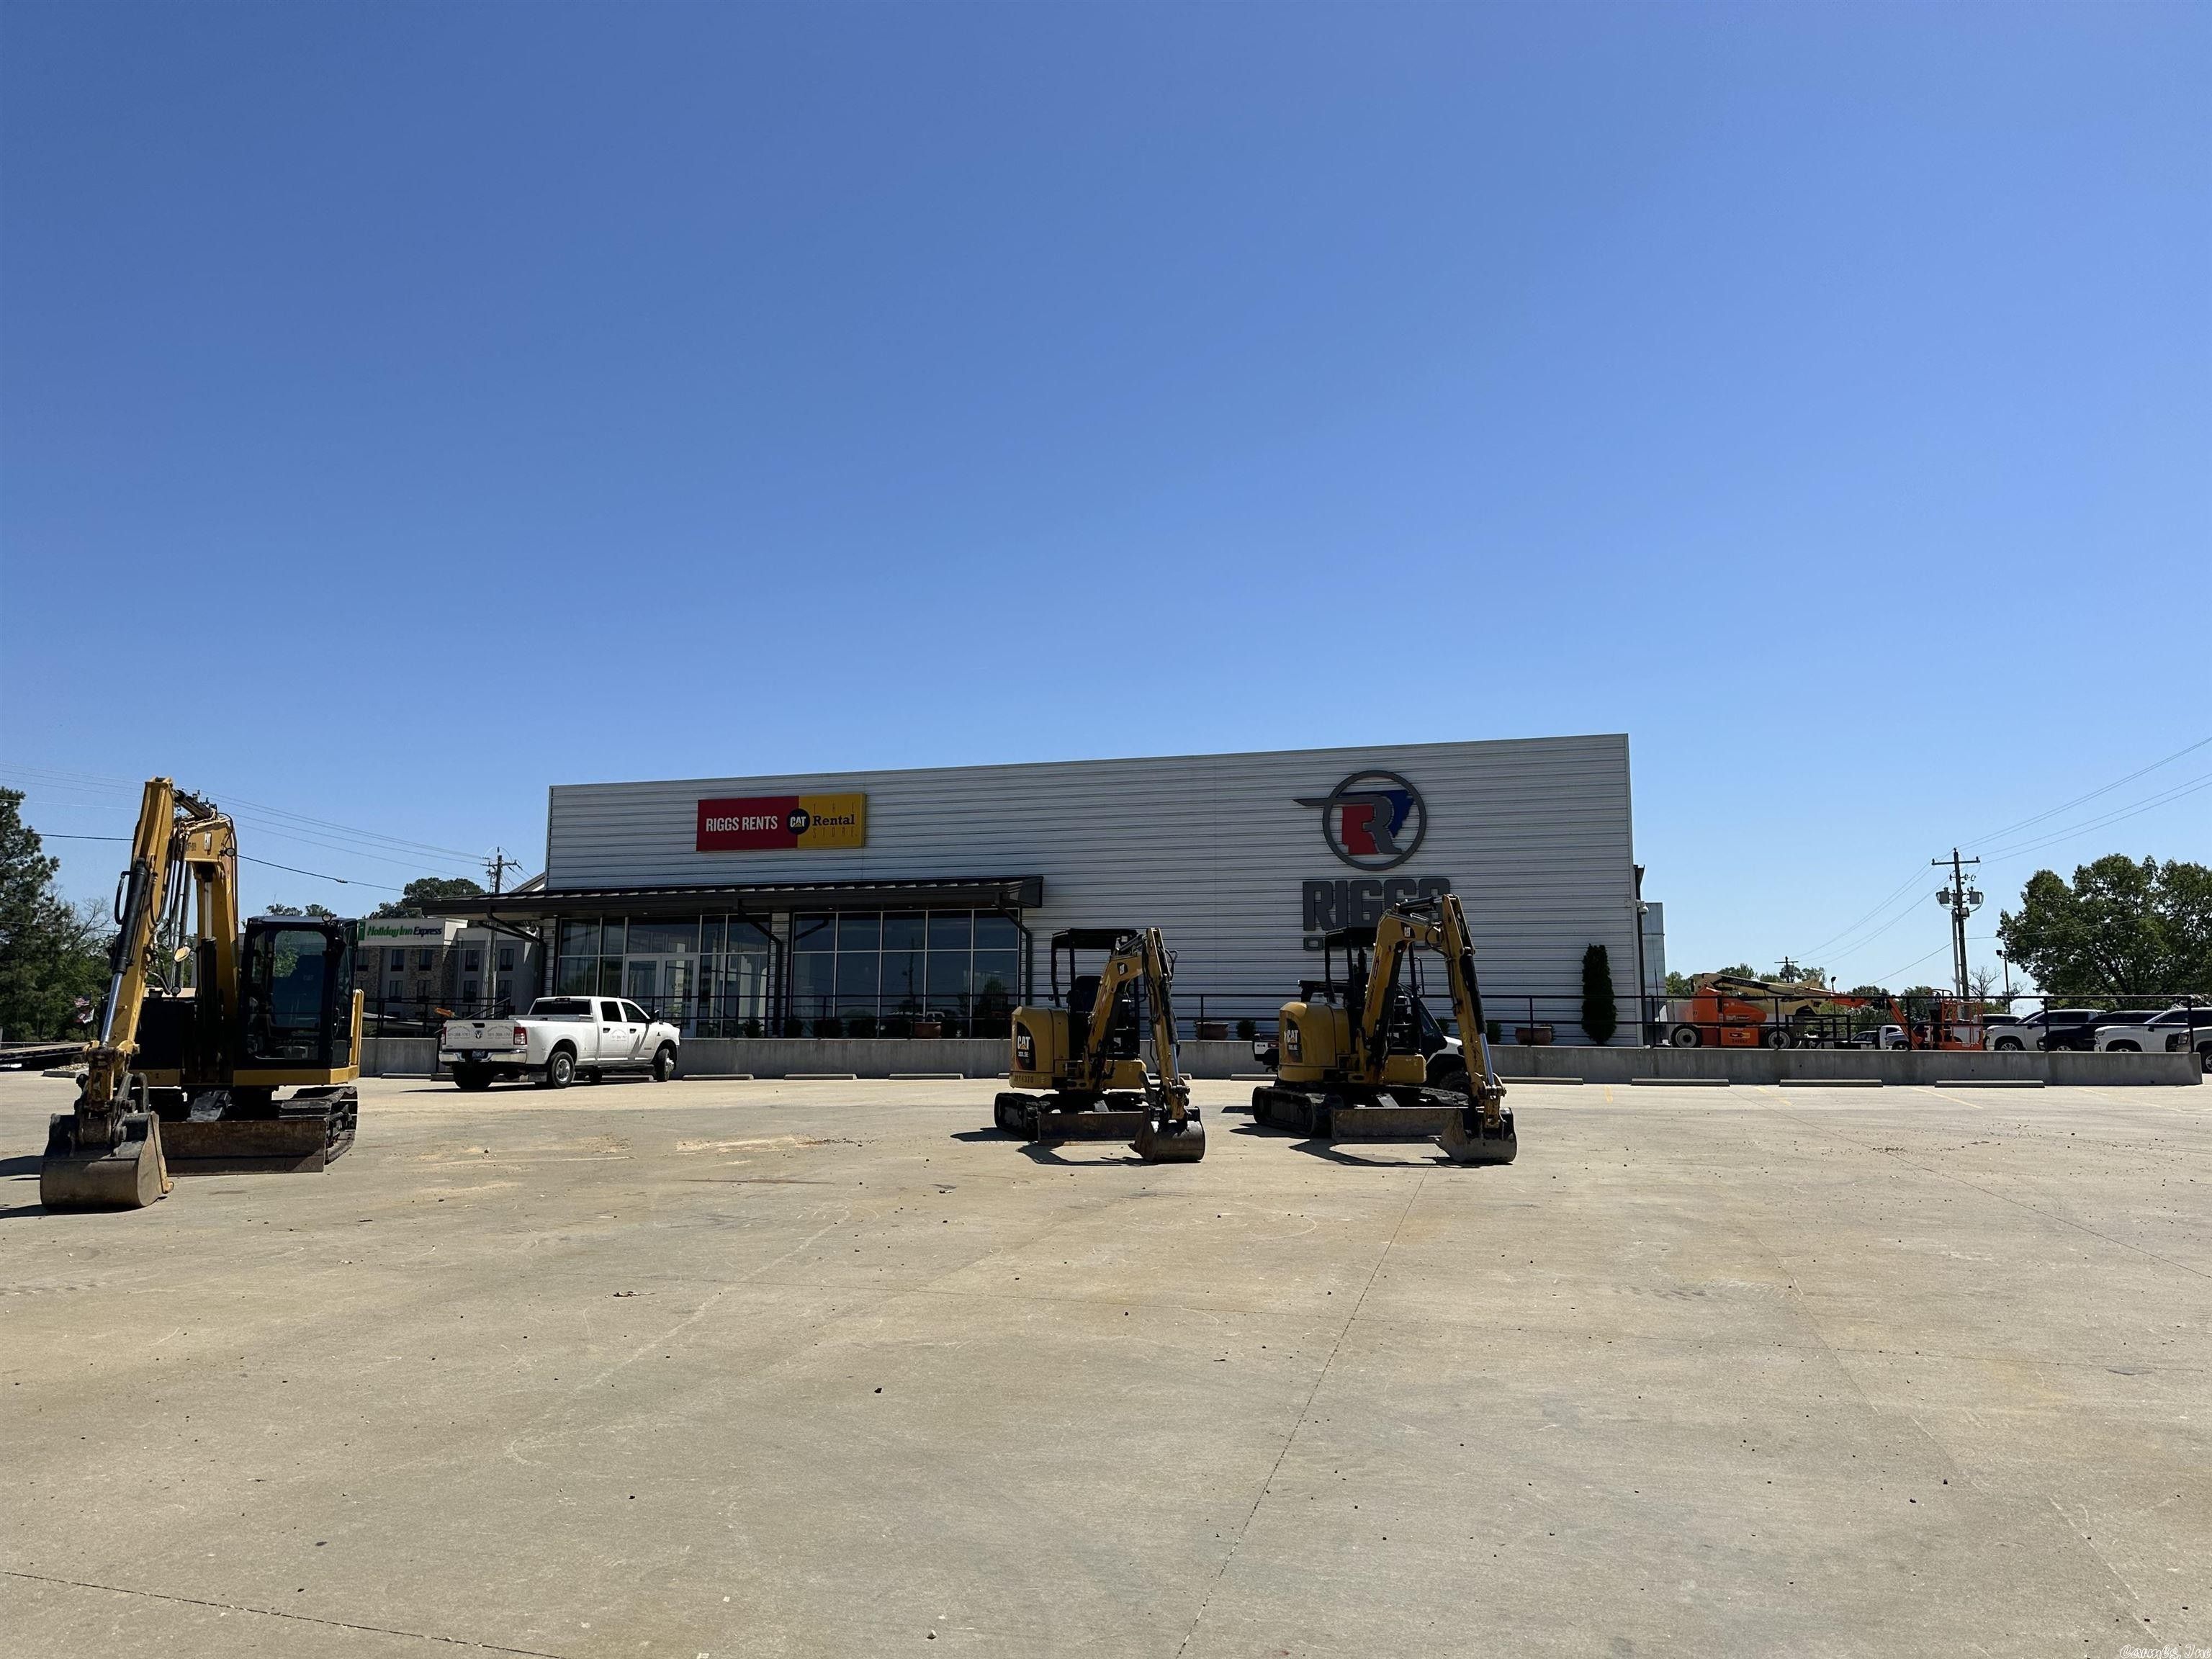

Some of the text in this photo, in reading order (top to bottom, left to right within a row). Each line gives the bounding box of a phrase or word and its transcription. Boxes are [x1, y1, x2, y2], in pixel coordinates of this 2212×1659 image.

[706, 816, 778, 832] RIGGS RENTS
[789, 816, 806, 827] CAT
[812, 814, 855, 826] Rental
[367, 925, 443, 938] Holiday Inn Express
[1017, 1035, 1030, 1050] CAT
[1287, 1030, 1298, 1043] CAT
